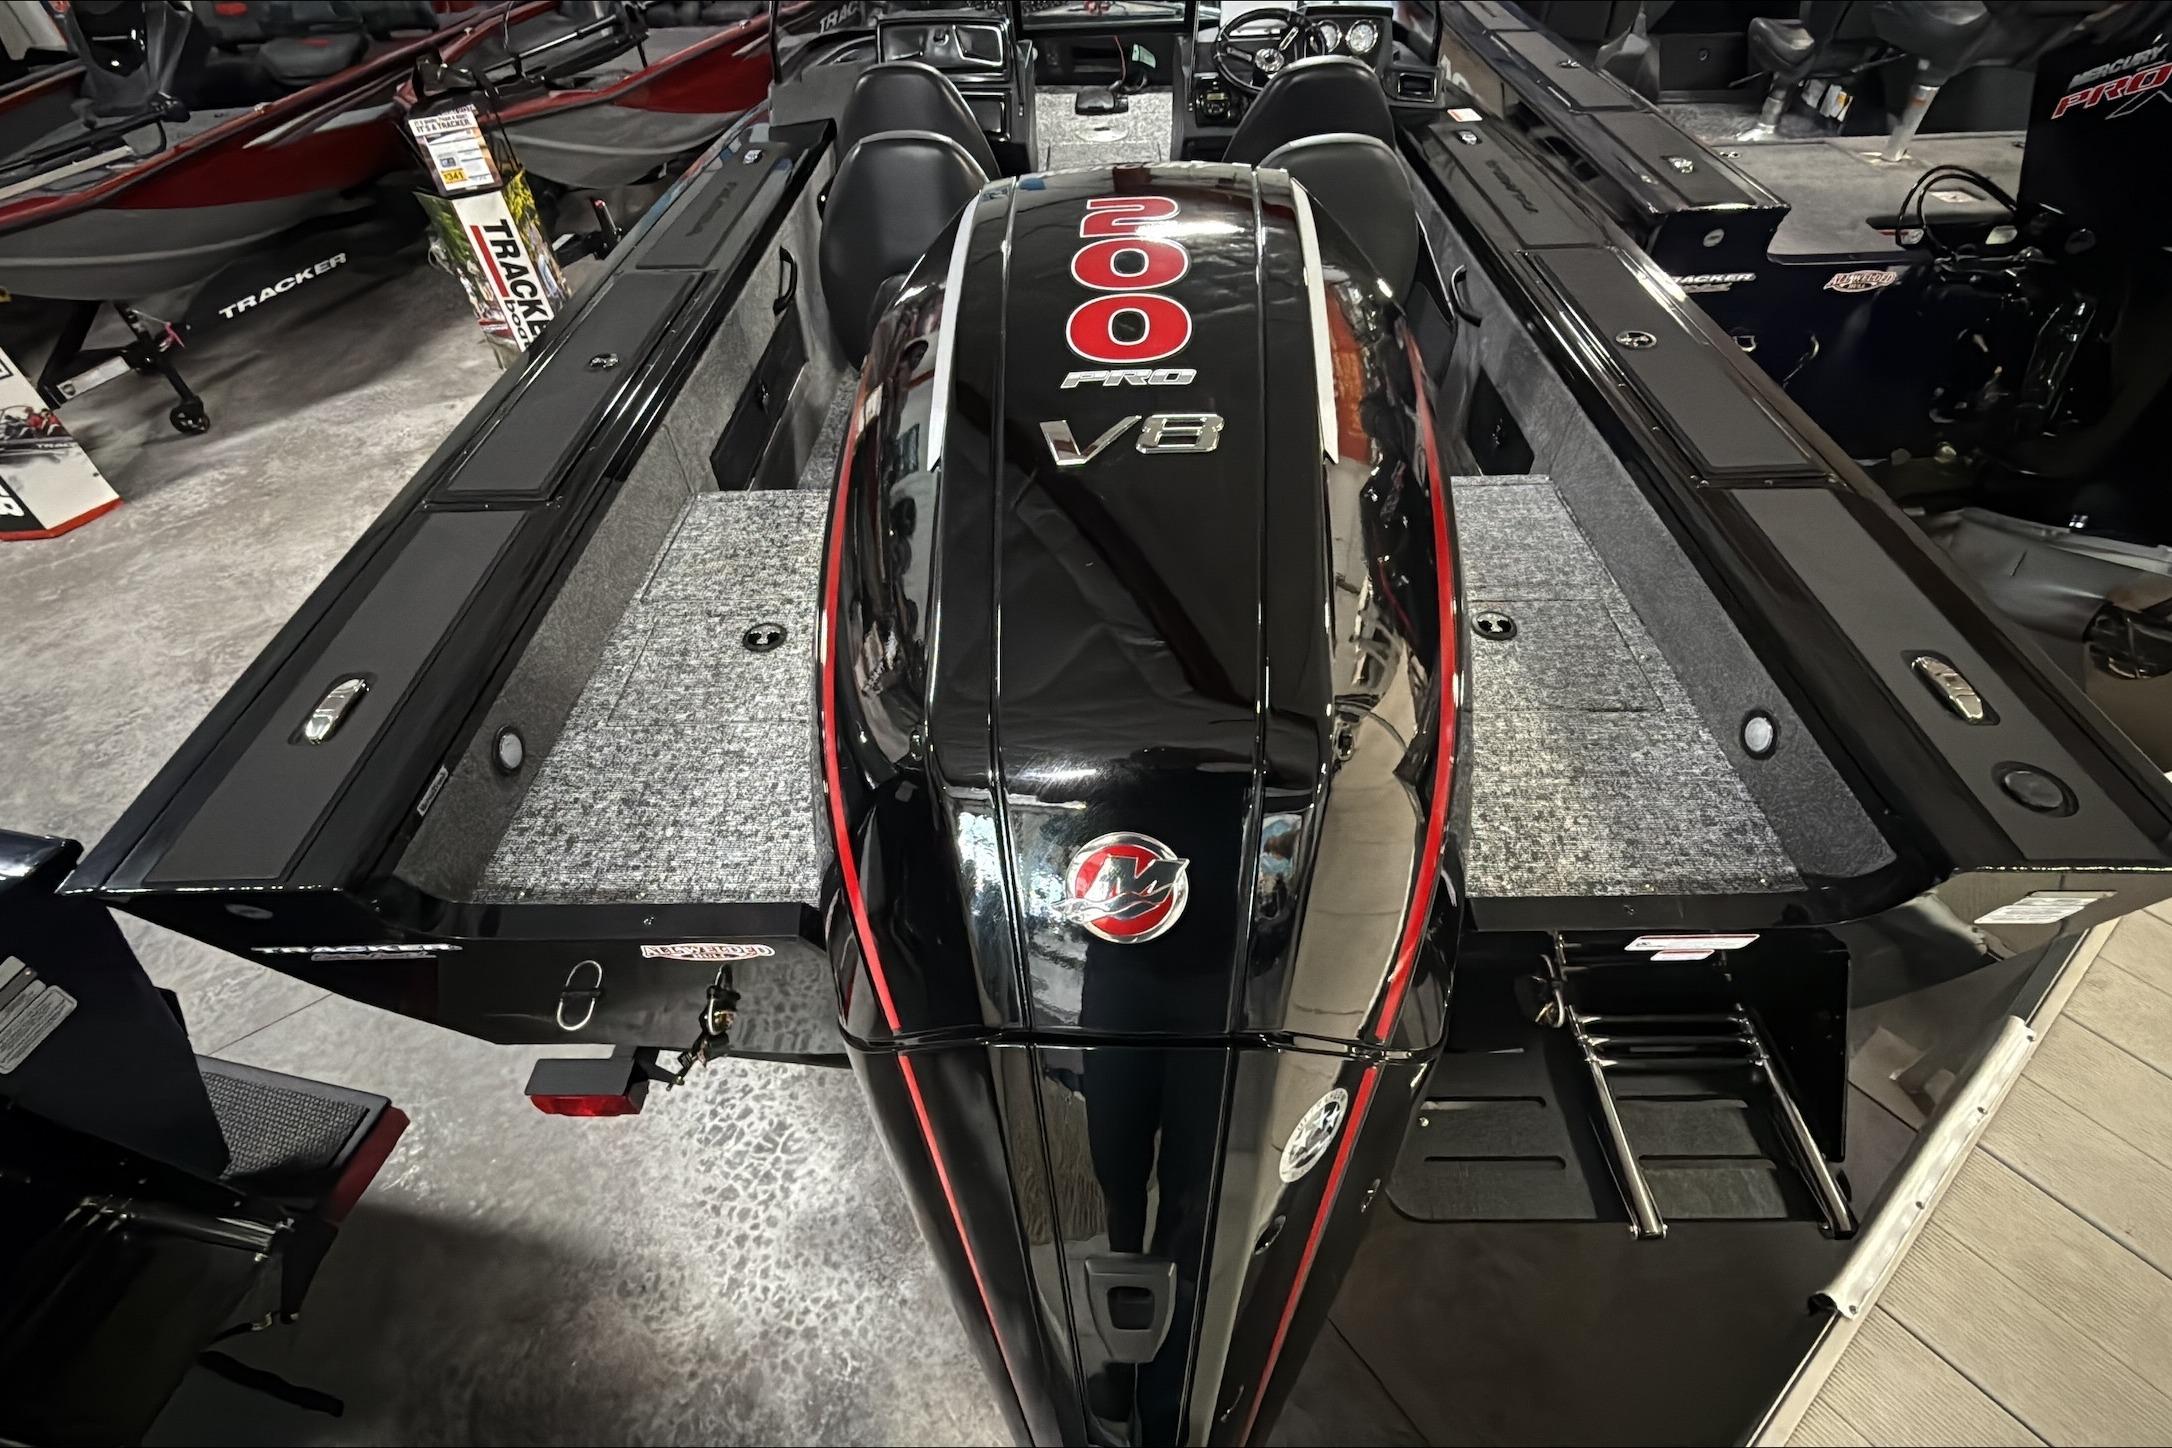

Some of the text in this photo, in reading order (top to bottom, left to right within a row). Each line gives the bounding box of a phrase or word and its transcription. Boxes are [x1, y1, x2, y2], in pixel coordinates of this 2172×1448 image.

[2051, 62, 2172, 120] PRO
[219, 252, 346, 319] TRACKER
[483, 219, 551, 338] TRACKE
[1065, 196, 1192, 364] 200
[1060, 368, 1197, 389] PRO
[1039, 413, 1225, 466] V8
